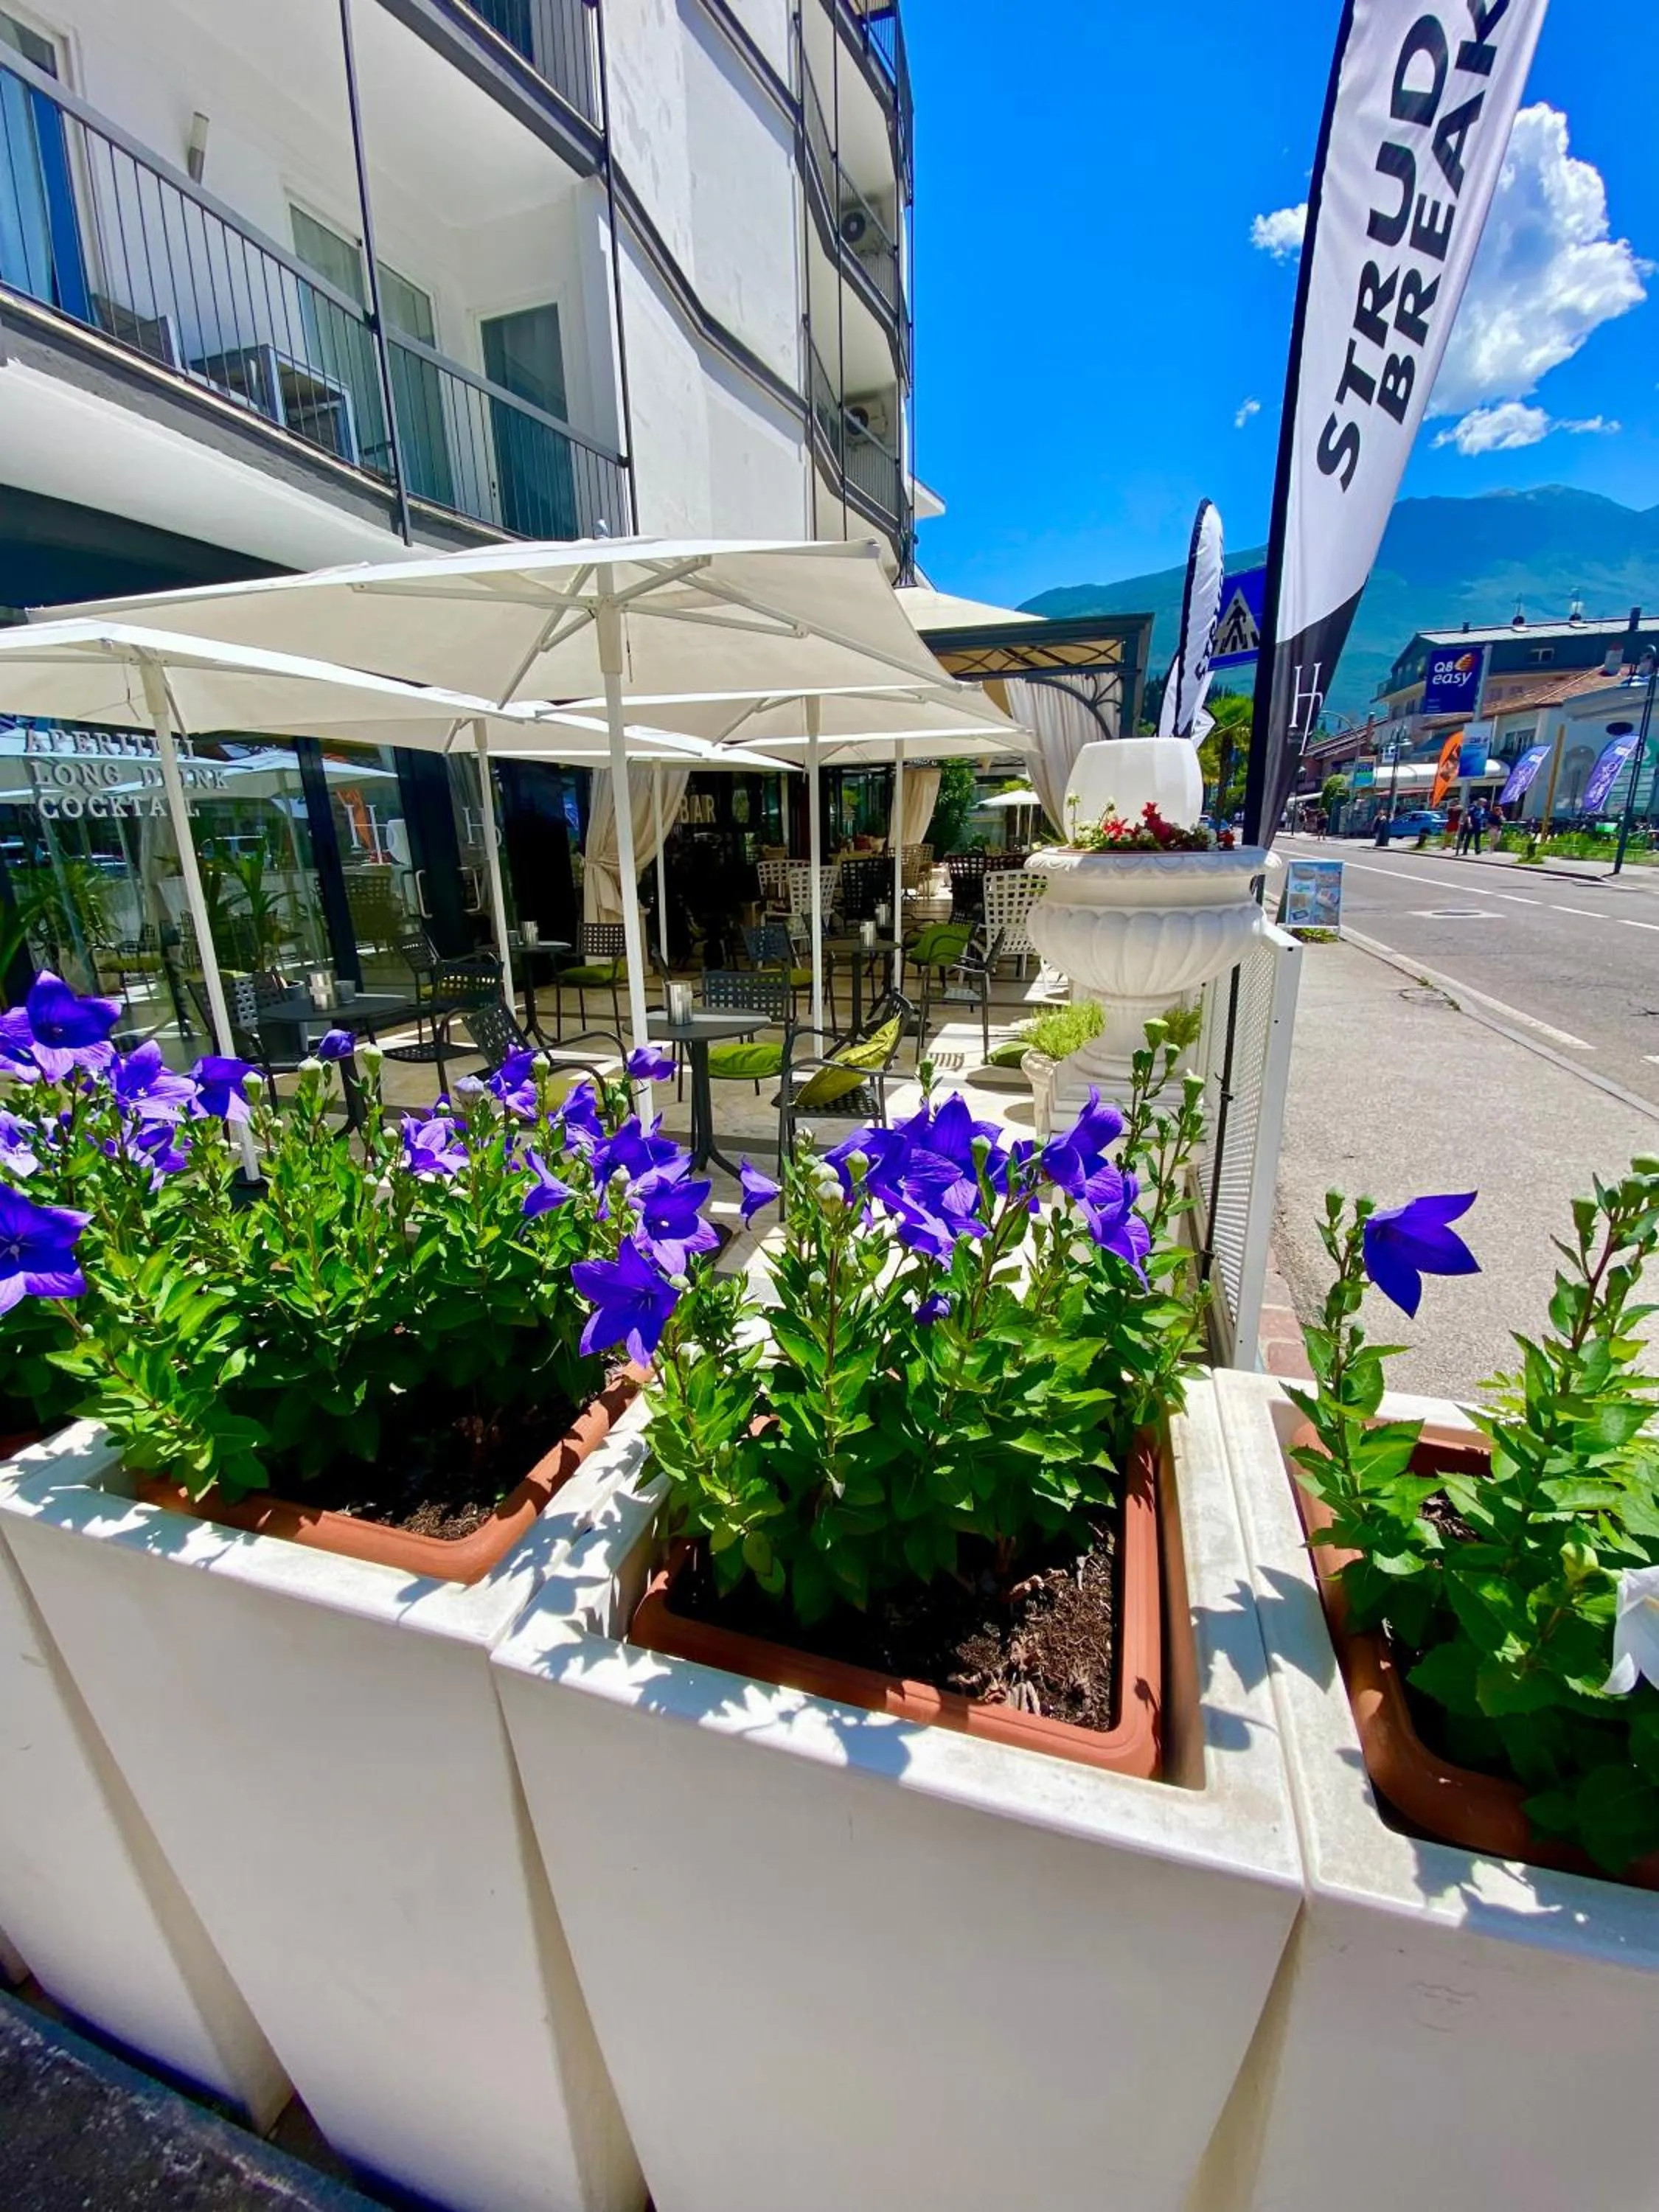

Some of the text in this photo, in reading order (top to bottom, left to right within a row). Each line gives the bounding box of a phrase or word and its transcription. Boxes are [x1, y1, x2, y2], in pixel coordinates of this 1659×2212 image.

[1377, 0, 1510, 425] BREAK
[1432, 672, 1472, 688] easy
[1434, 661, 1454, 673] Q8
[30, 760, 229, 790] LONG DINK
[38, 796, 200, 819] COCKTAL
[678, 794, 717, 824] BAR
